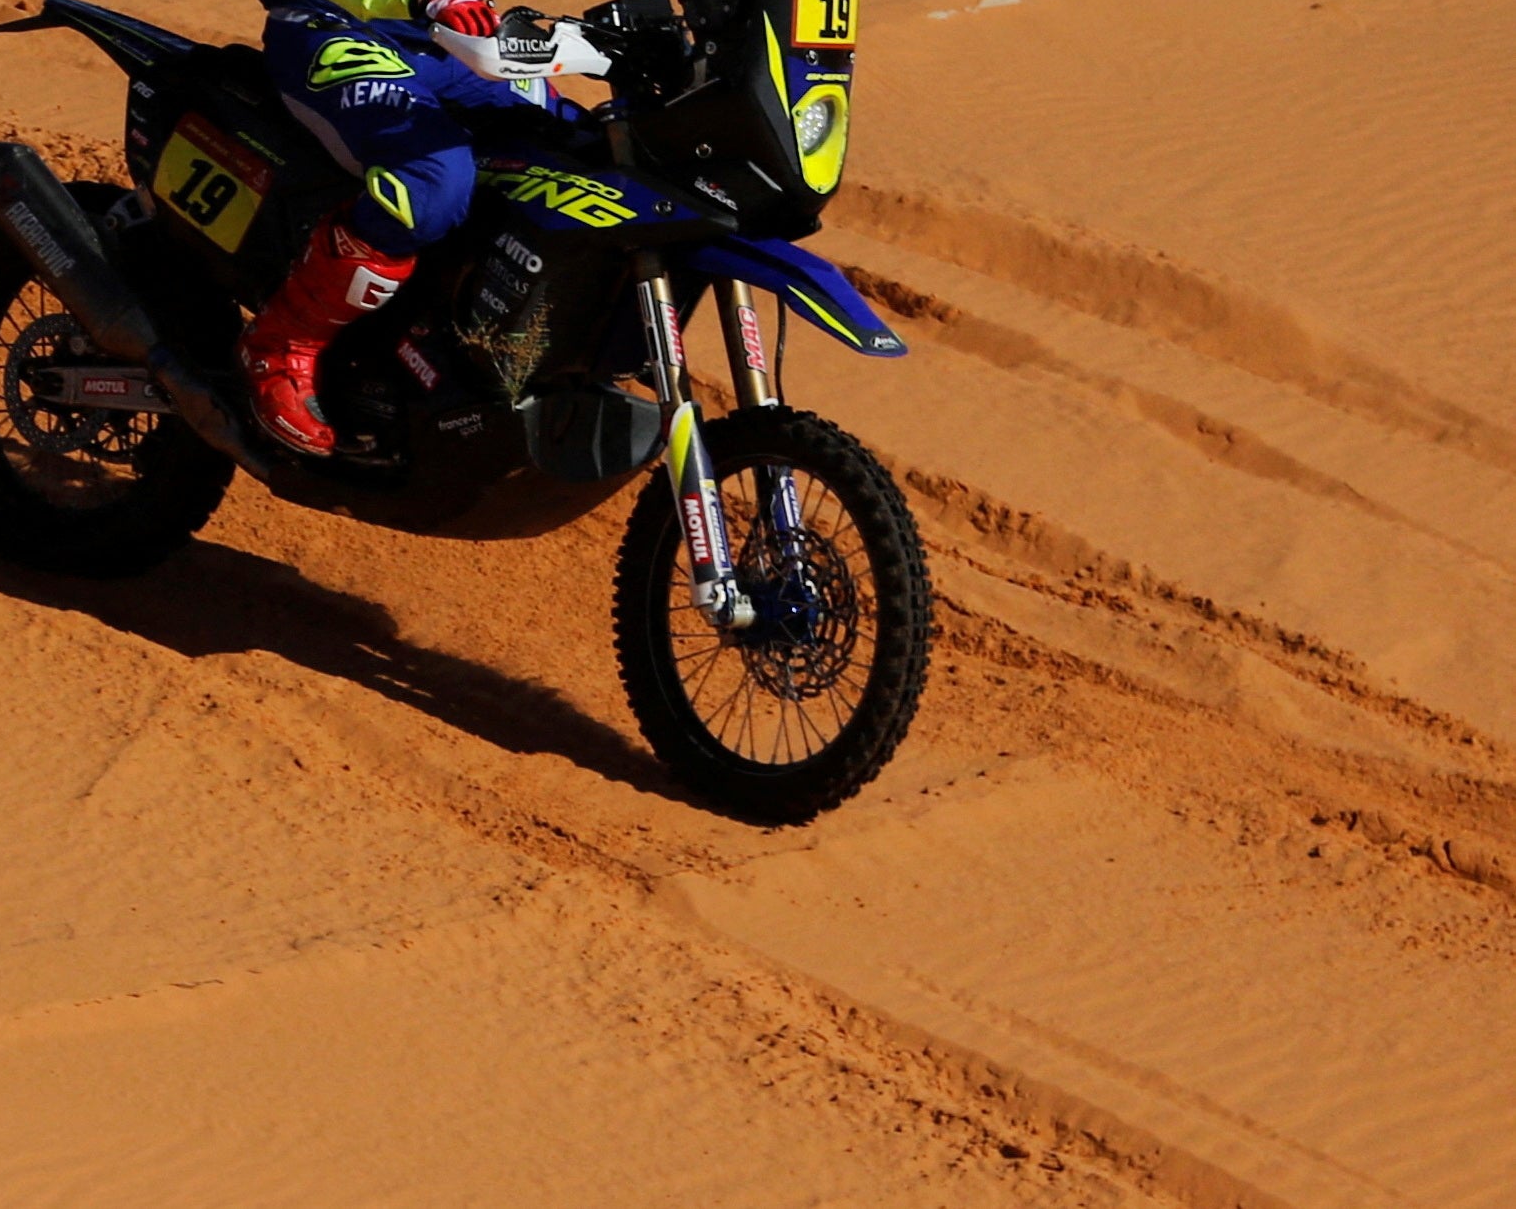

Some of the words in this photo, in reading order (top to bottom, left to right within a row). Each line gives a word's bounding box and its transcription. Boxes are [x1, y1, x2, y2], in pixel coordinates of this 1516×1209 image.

[340, 81, 418, 111] KENNY
[170, 158, 238, 226] 19
[524, 165, 625, 201] SHERCO
[494, 232, 544, 274] AVITO
[737, 307, 766, 371] MAC
[84, 379, 126, 394] MOTUL
[683, 498, 709, 562] MOTUL
